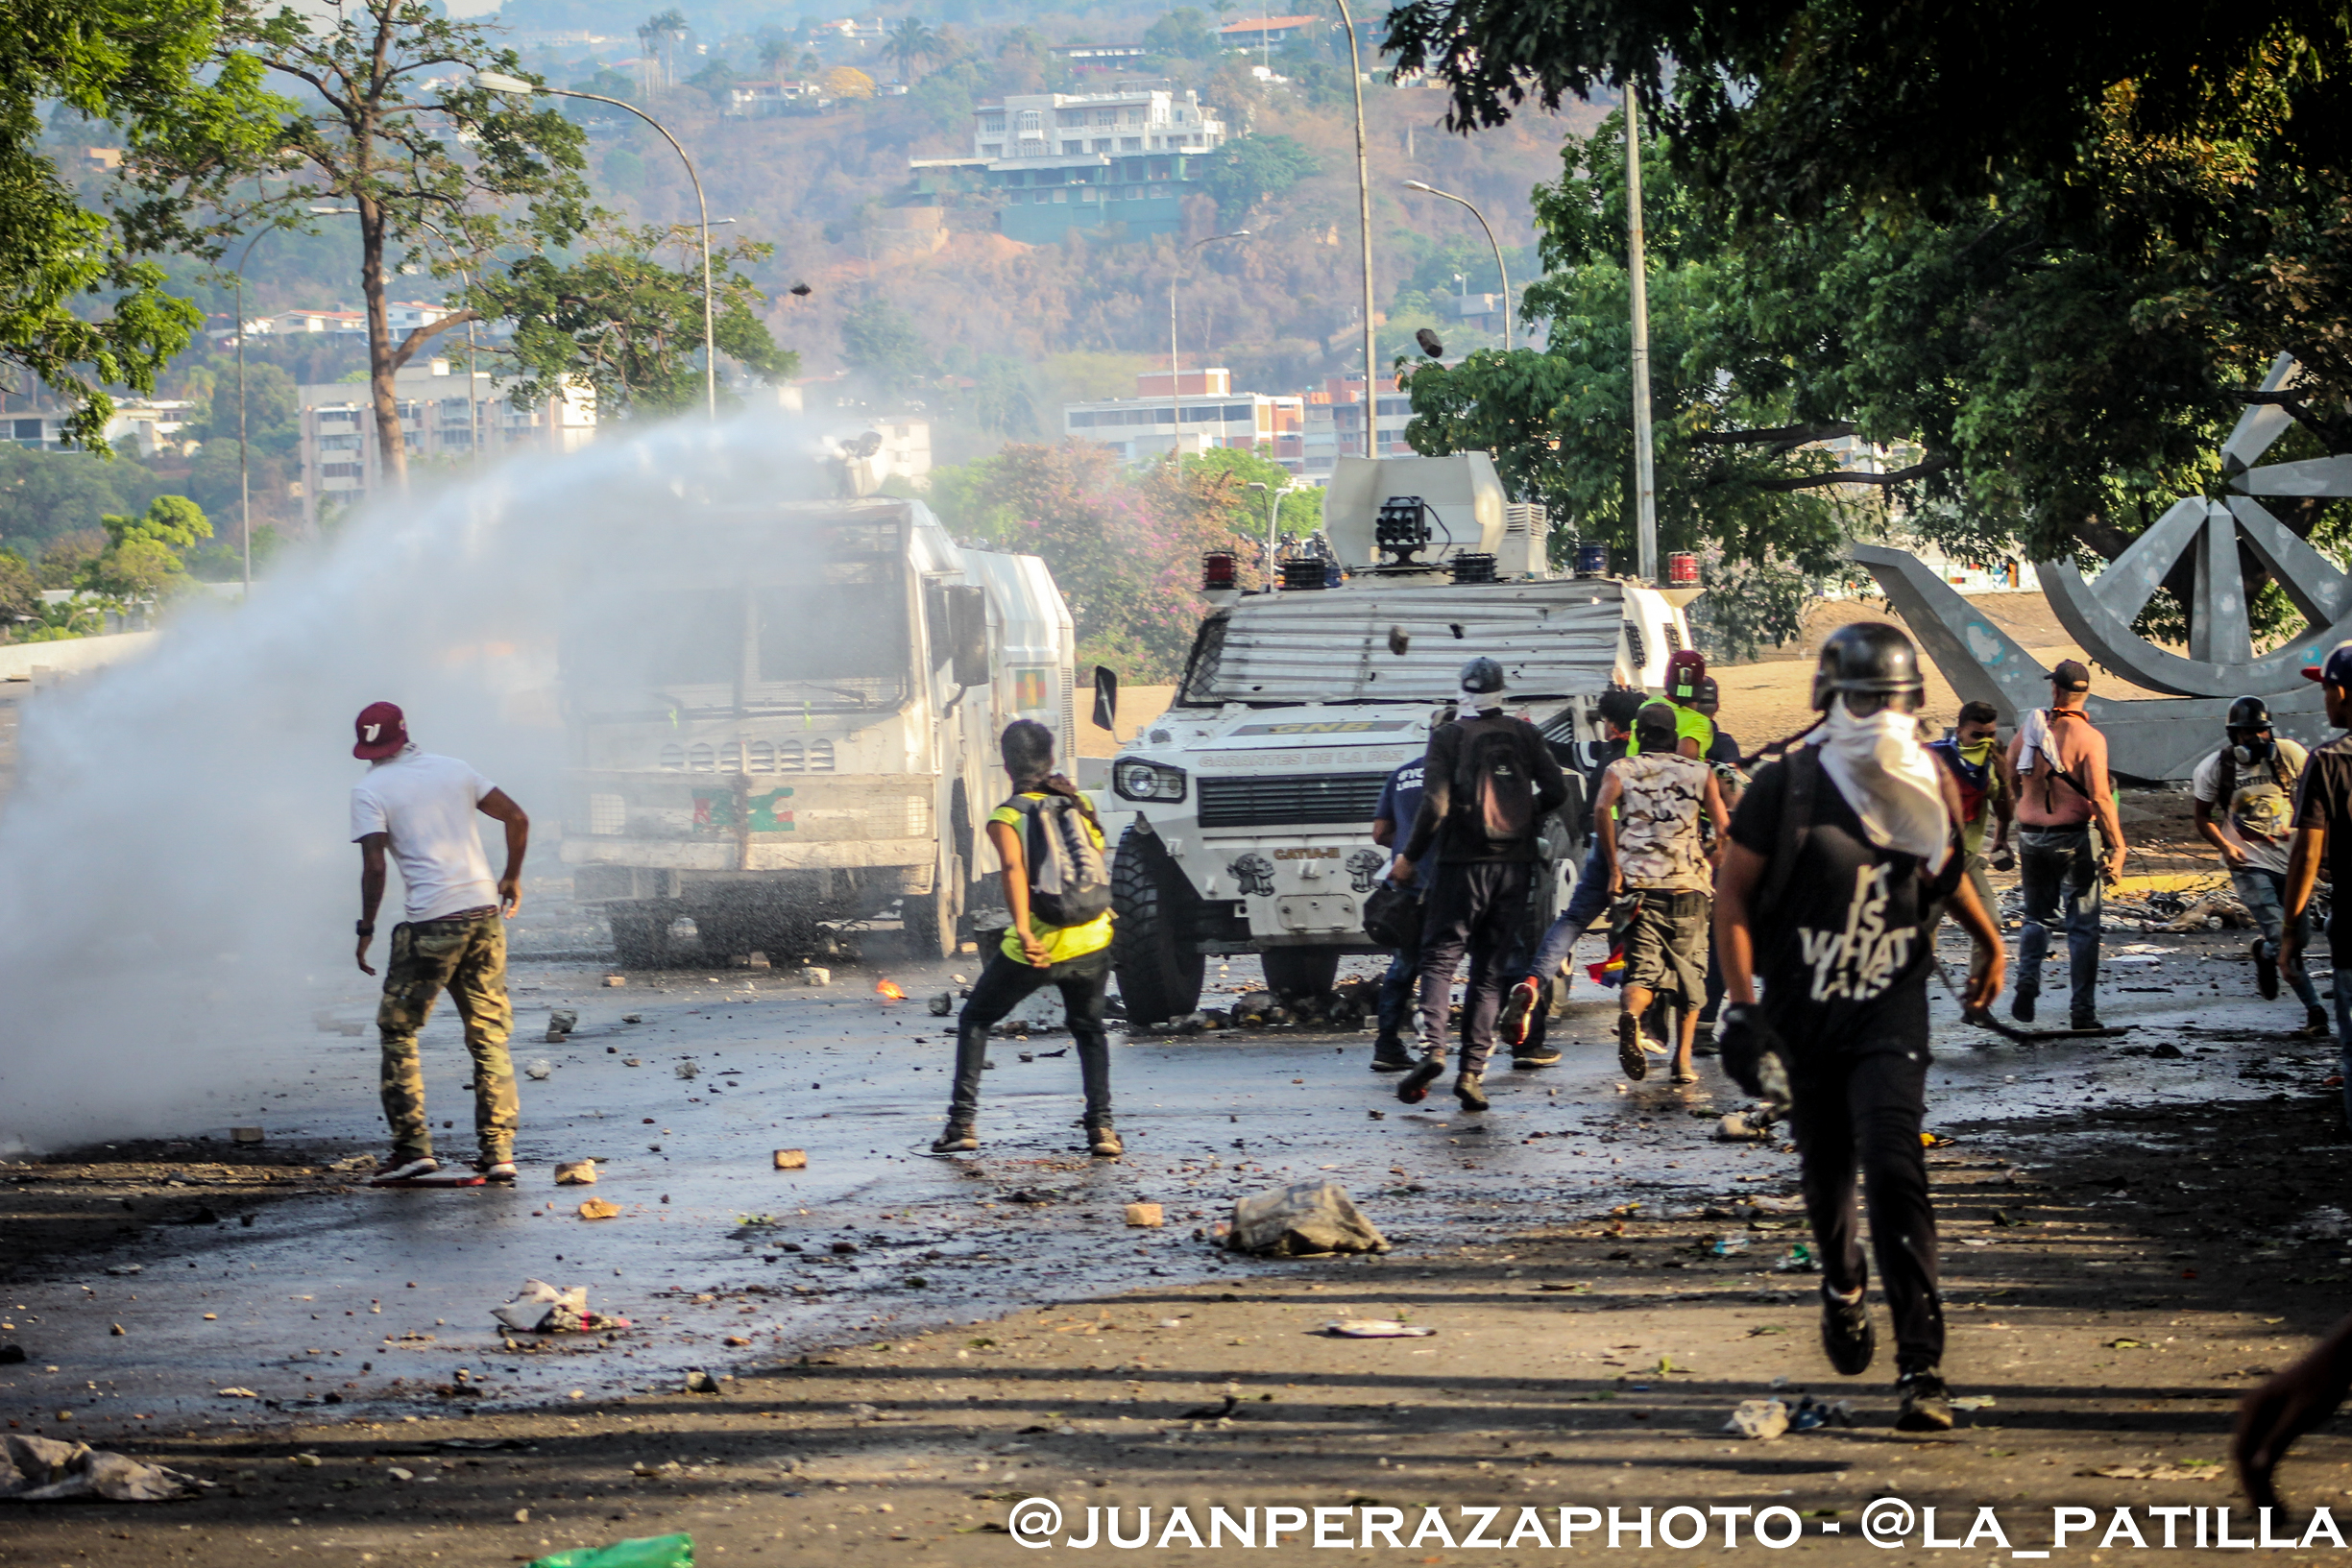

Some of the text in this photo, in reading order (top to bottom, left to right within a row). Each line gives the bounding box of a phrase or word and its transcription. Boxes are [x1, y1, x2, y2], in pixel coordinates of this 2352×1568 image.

[1271, 721, 1374, 735] GNB
[1199, 750, 1405, 768] GARANTES DE LA PAZ
[1797, 926, 1918, 974] WHAT
